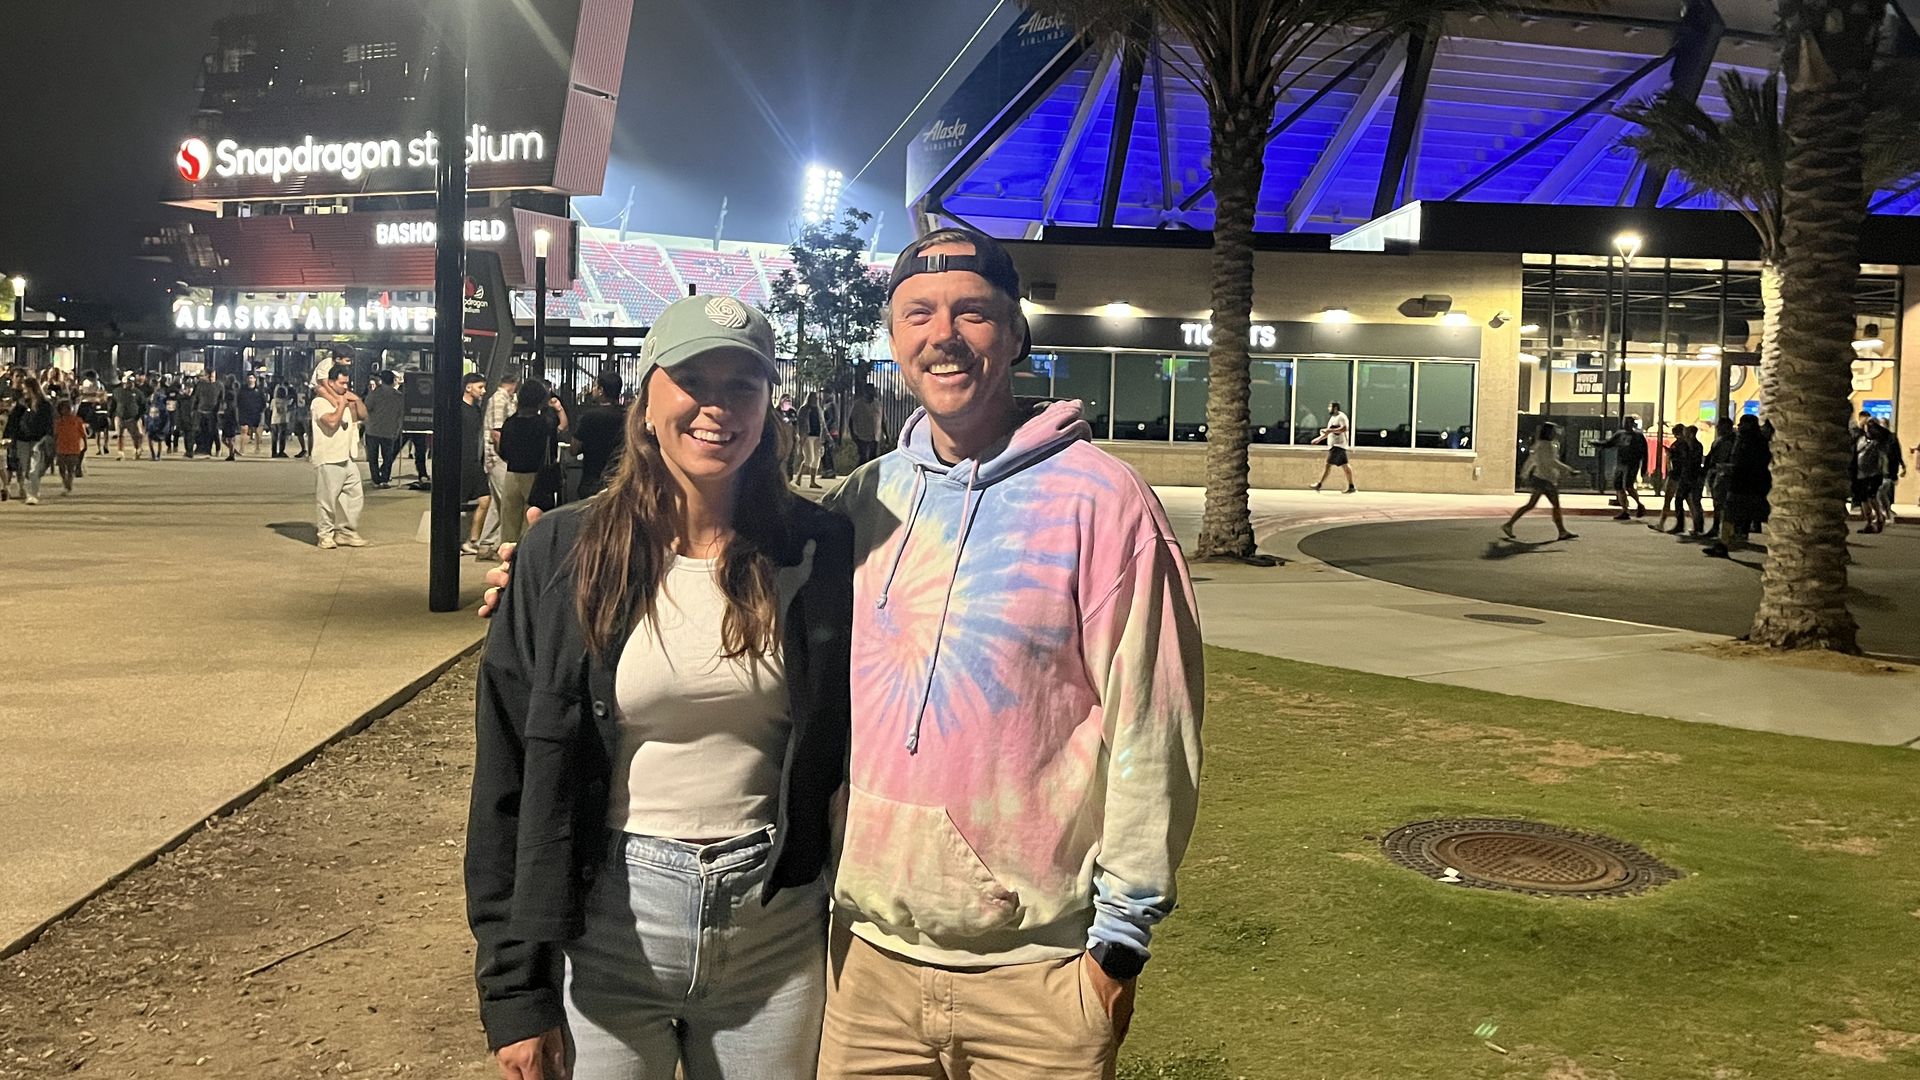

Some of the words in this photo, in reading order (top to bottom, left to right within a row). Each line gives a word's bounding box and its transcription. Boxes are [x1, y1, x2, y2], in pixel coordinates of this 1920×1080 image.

[923, 117, 967, 143] Alaska
[216, 135, 401, 183] Snapdragon
[408, 123, 544, 166] stdium
[376, 221, 437, 244] BASHO
[464, 219, 506, 241] IELD
[175, 305, 293, 329] ALASKA
[304, 306, 430, 330] AIRLINE
[1180, 323, 1276, 348] TICTS
